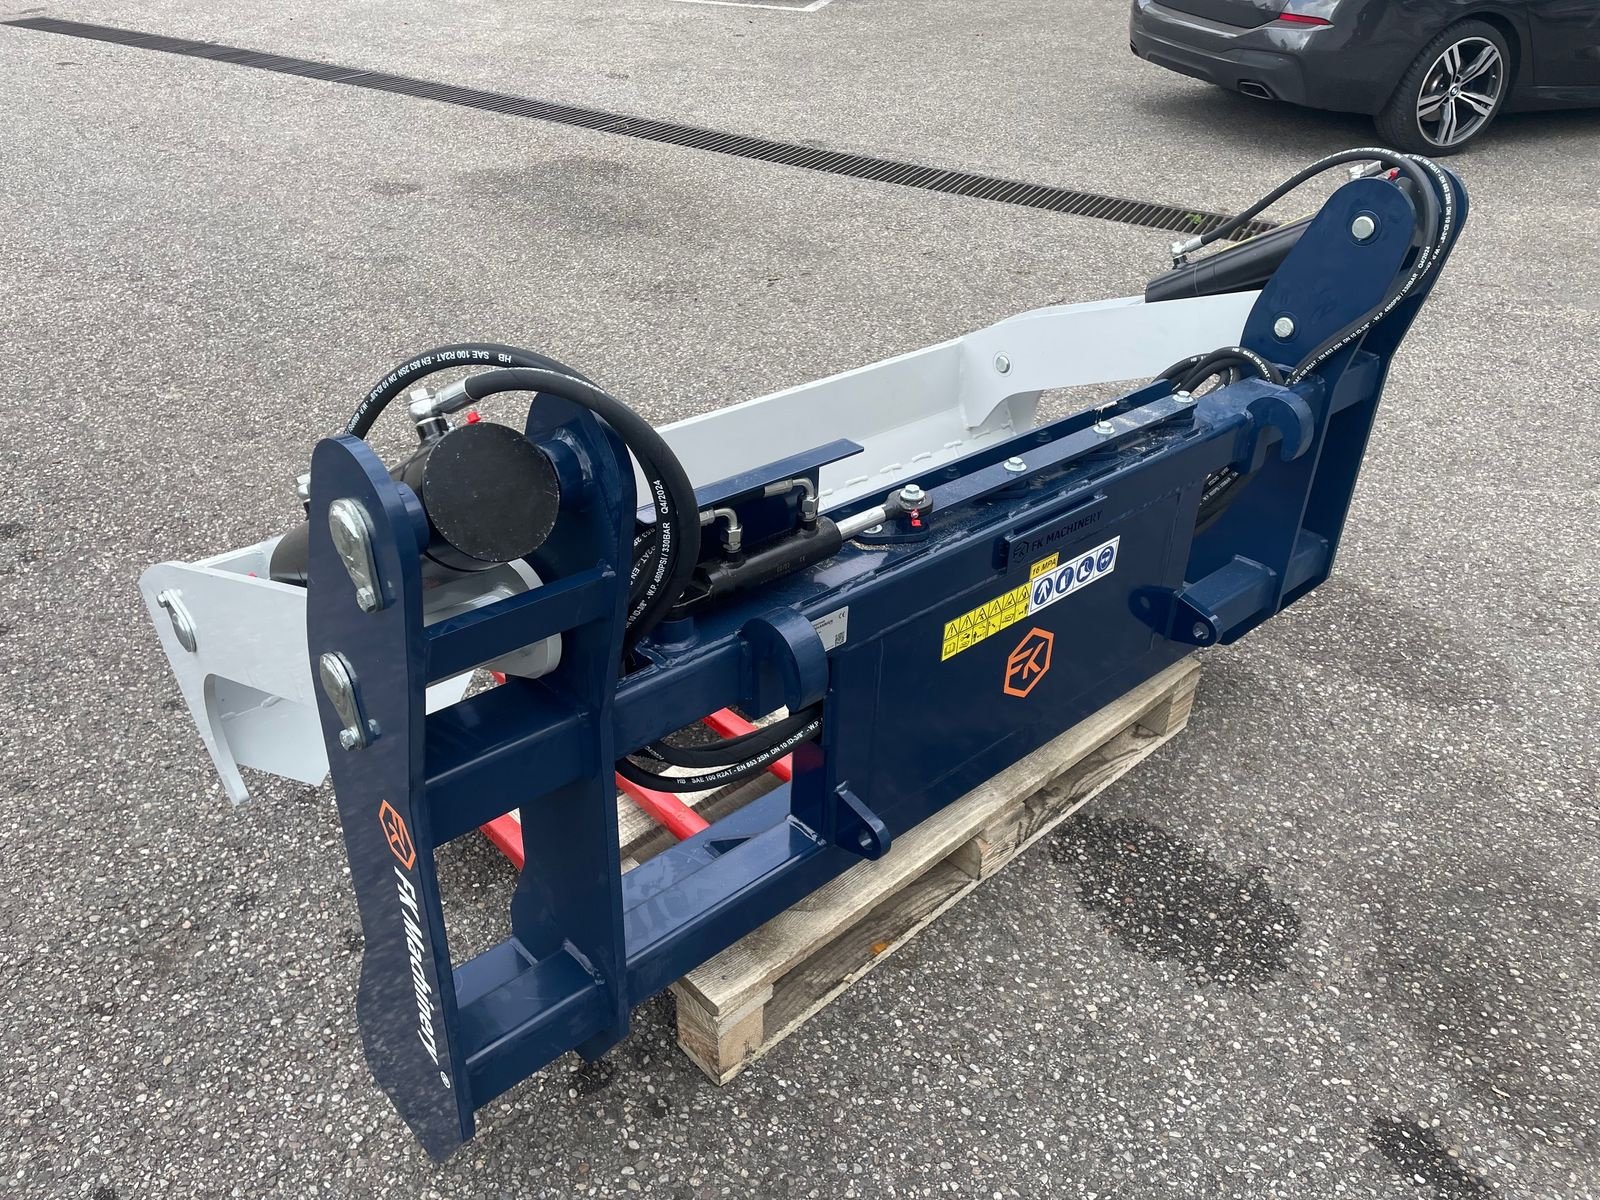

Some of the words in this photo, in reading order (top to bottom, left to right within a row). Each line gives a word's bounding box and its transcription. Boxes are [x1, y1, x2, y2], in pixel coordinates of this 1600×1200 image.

[436, 351, 456, 363] R2AT
[456, 350, 470, 359] 100
[472, 350, 489, 359] SAE
[498, 353, 512, 363] HB
[410, 360, 422, 371] 853
[422, 357, 432, 366] EN
[399, 365, 410, 377] 2SN
[388, 373, 397, 384] DN
[653, 479, 669, 514] Q4/2024
[662, 522, 670, 552] 330BAR
[1032, 541, 1043, 552] FK
[1046, 511, 1103, 544] MACHINERY
[630, 567, 640, 579] EN
[716, 770, 733, 779] R2AT
[757, 752, 770, 763] 2SN
[770, 747, 780, 756] DN
[394, 866, 420, 923] FK
[401, 908, 439, 1066] Machinery
